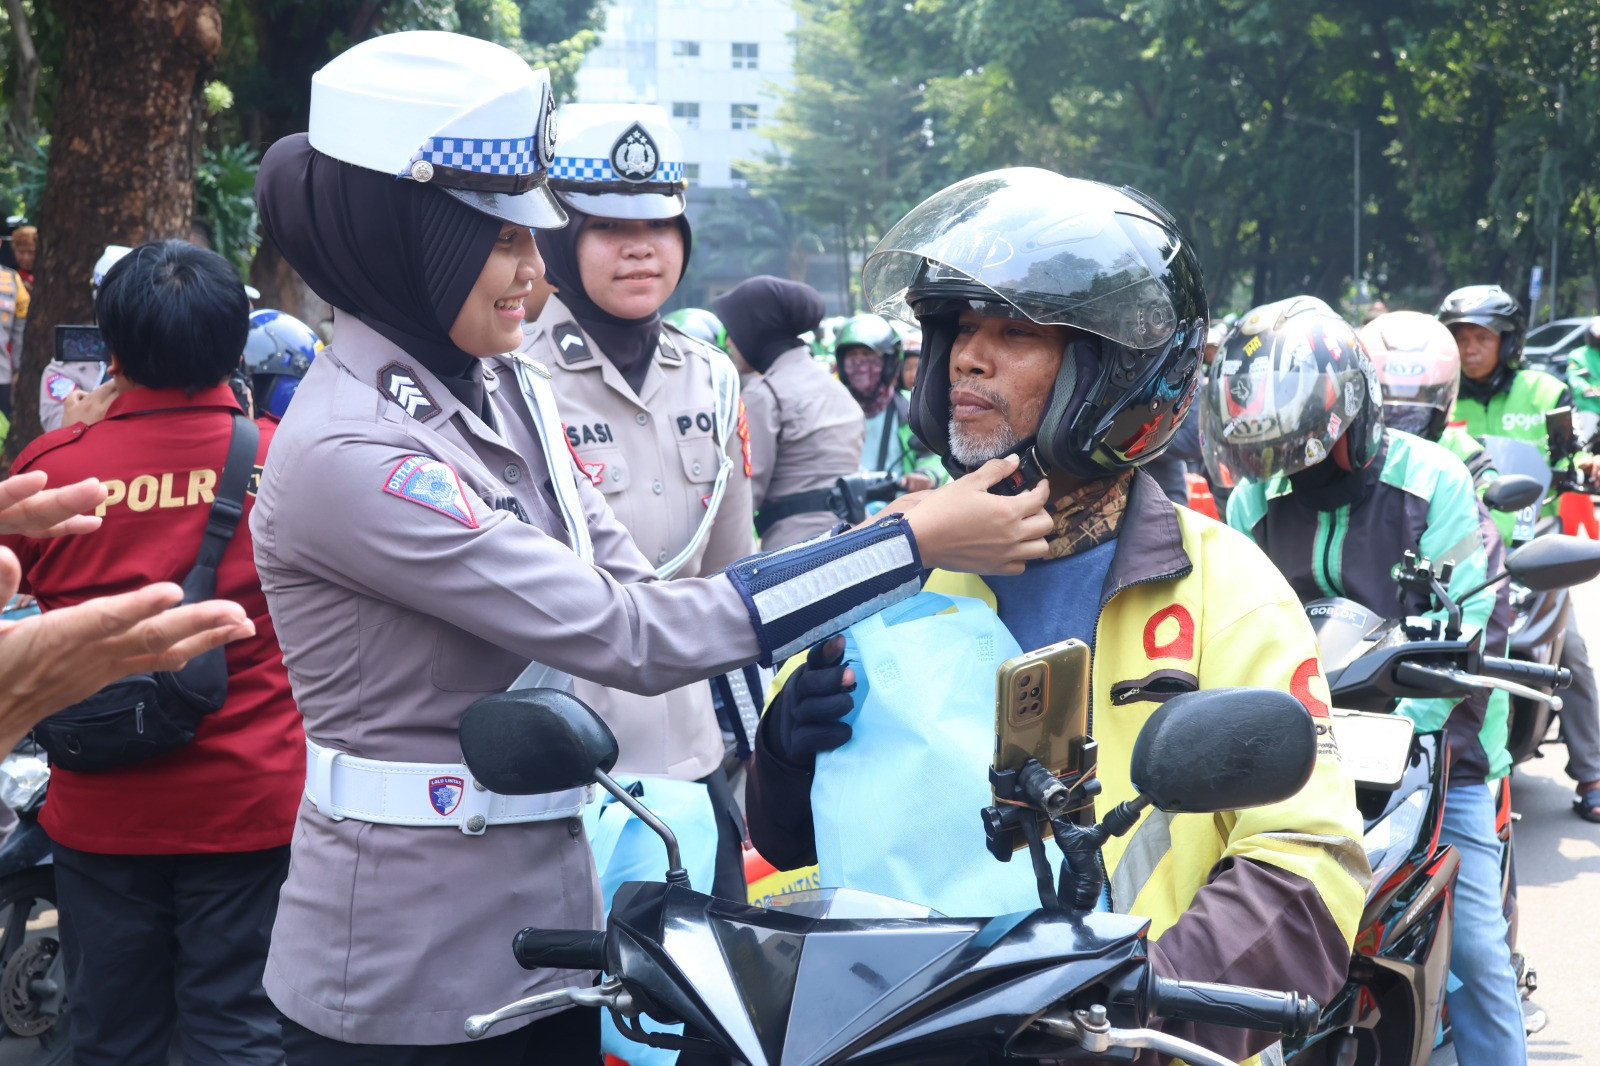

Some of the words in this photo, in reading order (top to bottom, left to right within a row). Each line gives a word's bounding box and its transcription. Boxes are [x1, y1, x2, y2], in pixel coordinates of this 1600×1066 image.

[95, 468, 226, 517] POLR
[1310, 606, 1357, 622] GOBLOK
[1406, 886, 1435, 924] HONDA
